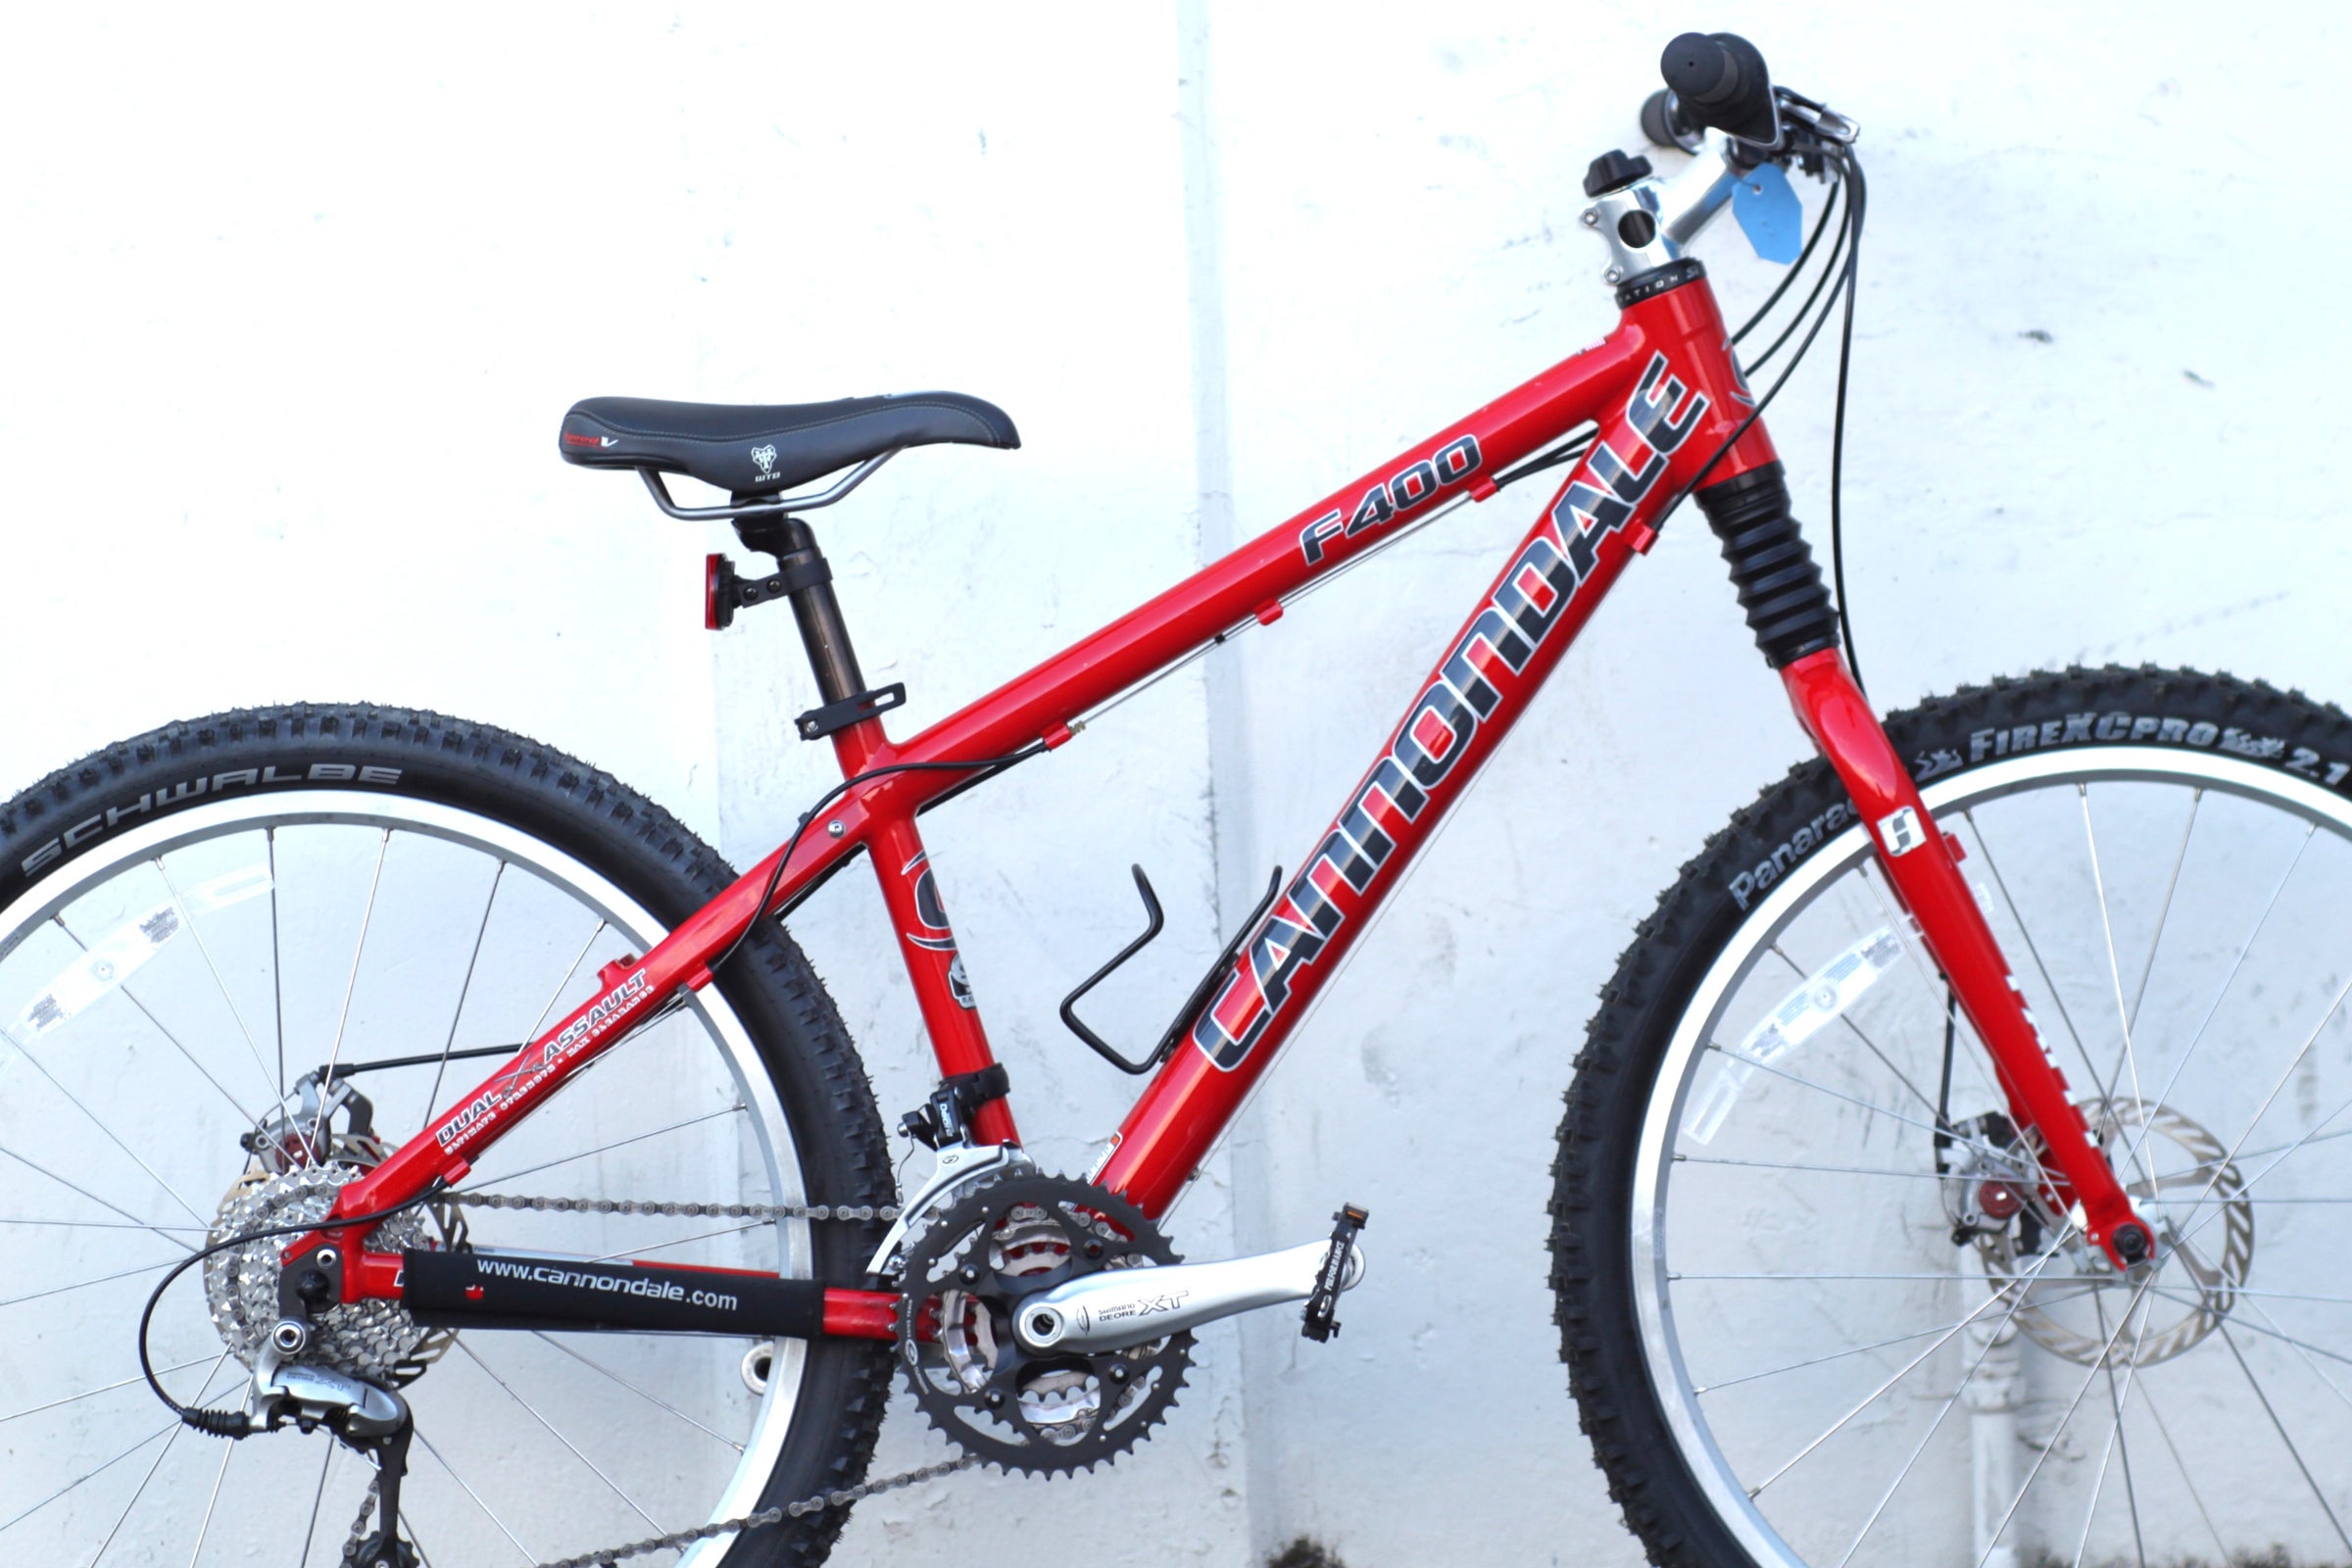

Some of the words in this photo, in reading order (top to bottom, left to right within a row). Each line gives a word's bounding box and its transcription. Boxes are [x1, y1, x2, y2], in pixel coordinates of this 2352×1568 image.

[1298, 434, 1481, 565] F400
[1193, 351, 1709, 1072] CANNONDALE
[2285, 747, 2351, 786] 2.1
[22, 763, 403, 878] SCHWALBE
[435, 1090, 502, 1148] DUAL
[543, 968, 647, 1064] ASSAULT
[565, 1037, 591, 1057] MAX
[476, 1258, 738, 1311] www.cannondale.com
[1098, 1302, 1137, 1316] SHIMANO
[1099, 1309, 1137, 1323] DEORE
[1138, 1290, 1190, 1317] XT
